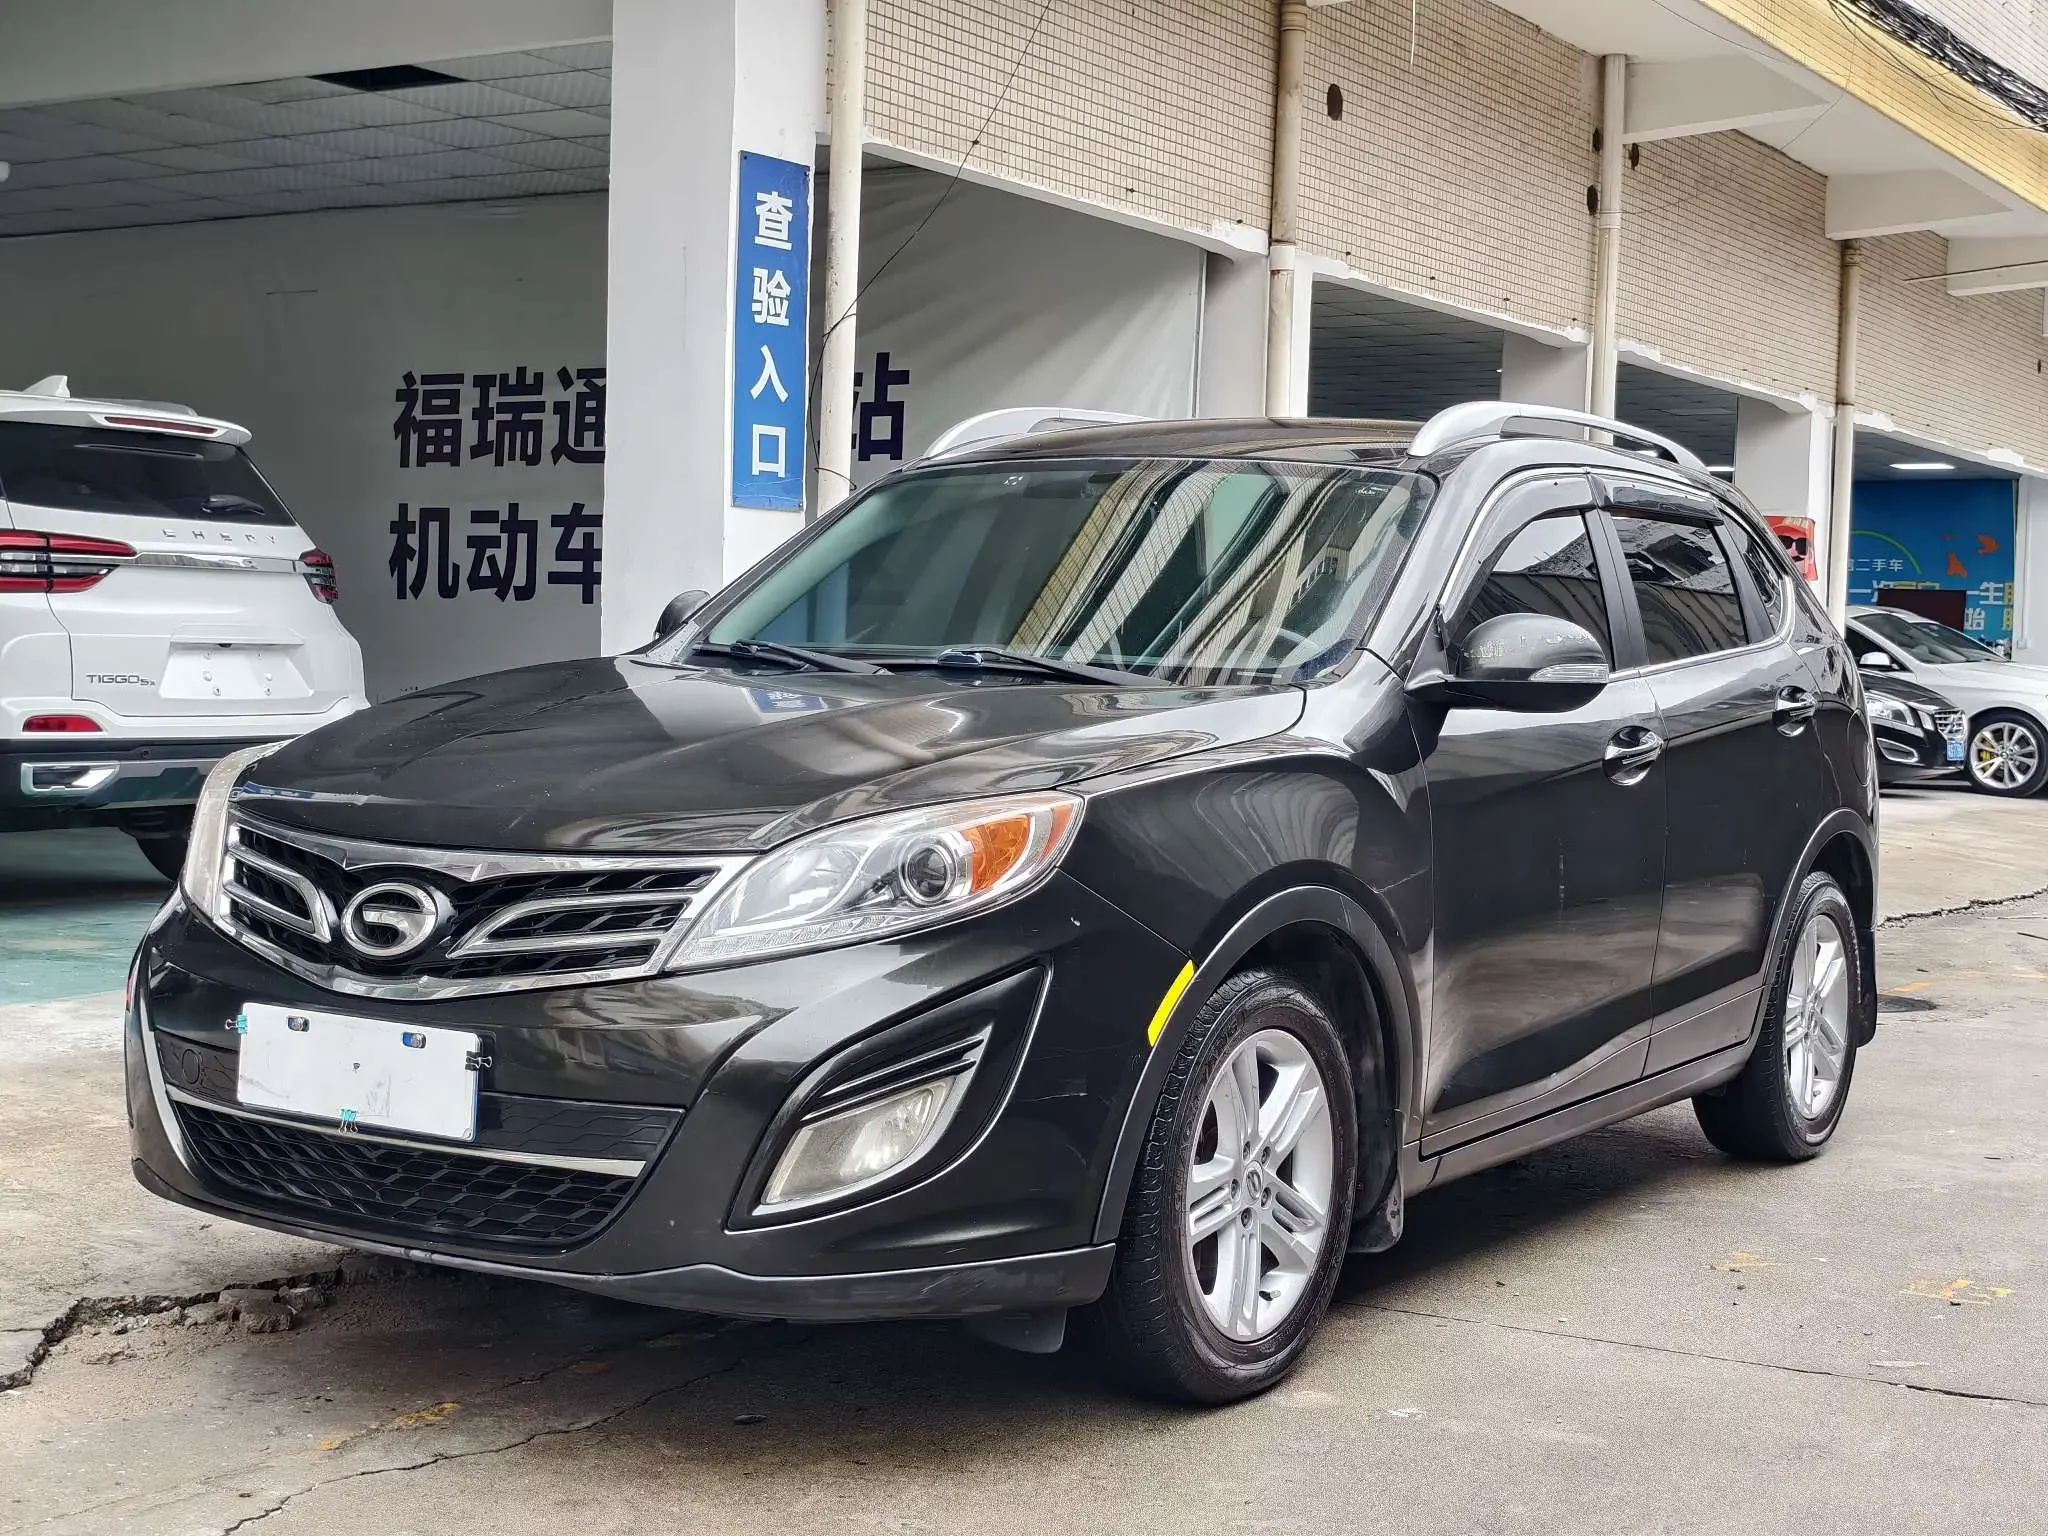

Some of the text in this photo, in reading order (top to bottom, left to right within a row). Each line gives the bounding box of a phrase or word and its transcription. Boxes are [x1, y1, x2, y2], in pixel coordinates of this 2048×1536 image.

[751, 191, 793, 478] 查验入口
[394, 352, 910, 468] 福瑞通 站
[389, 503, 603, 604] 机动车
